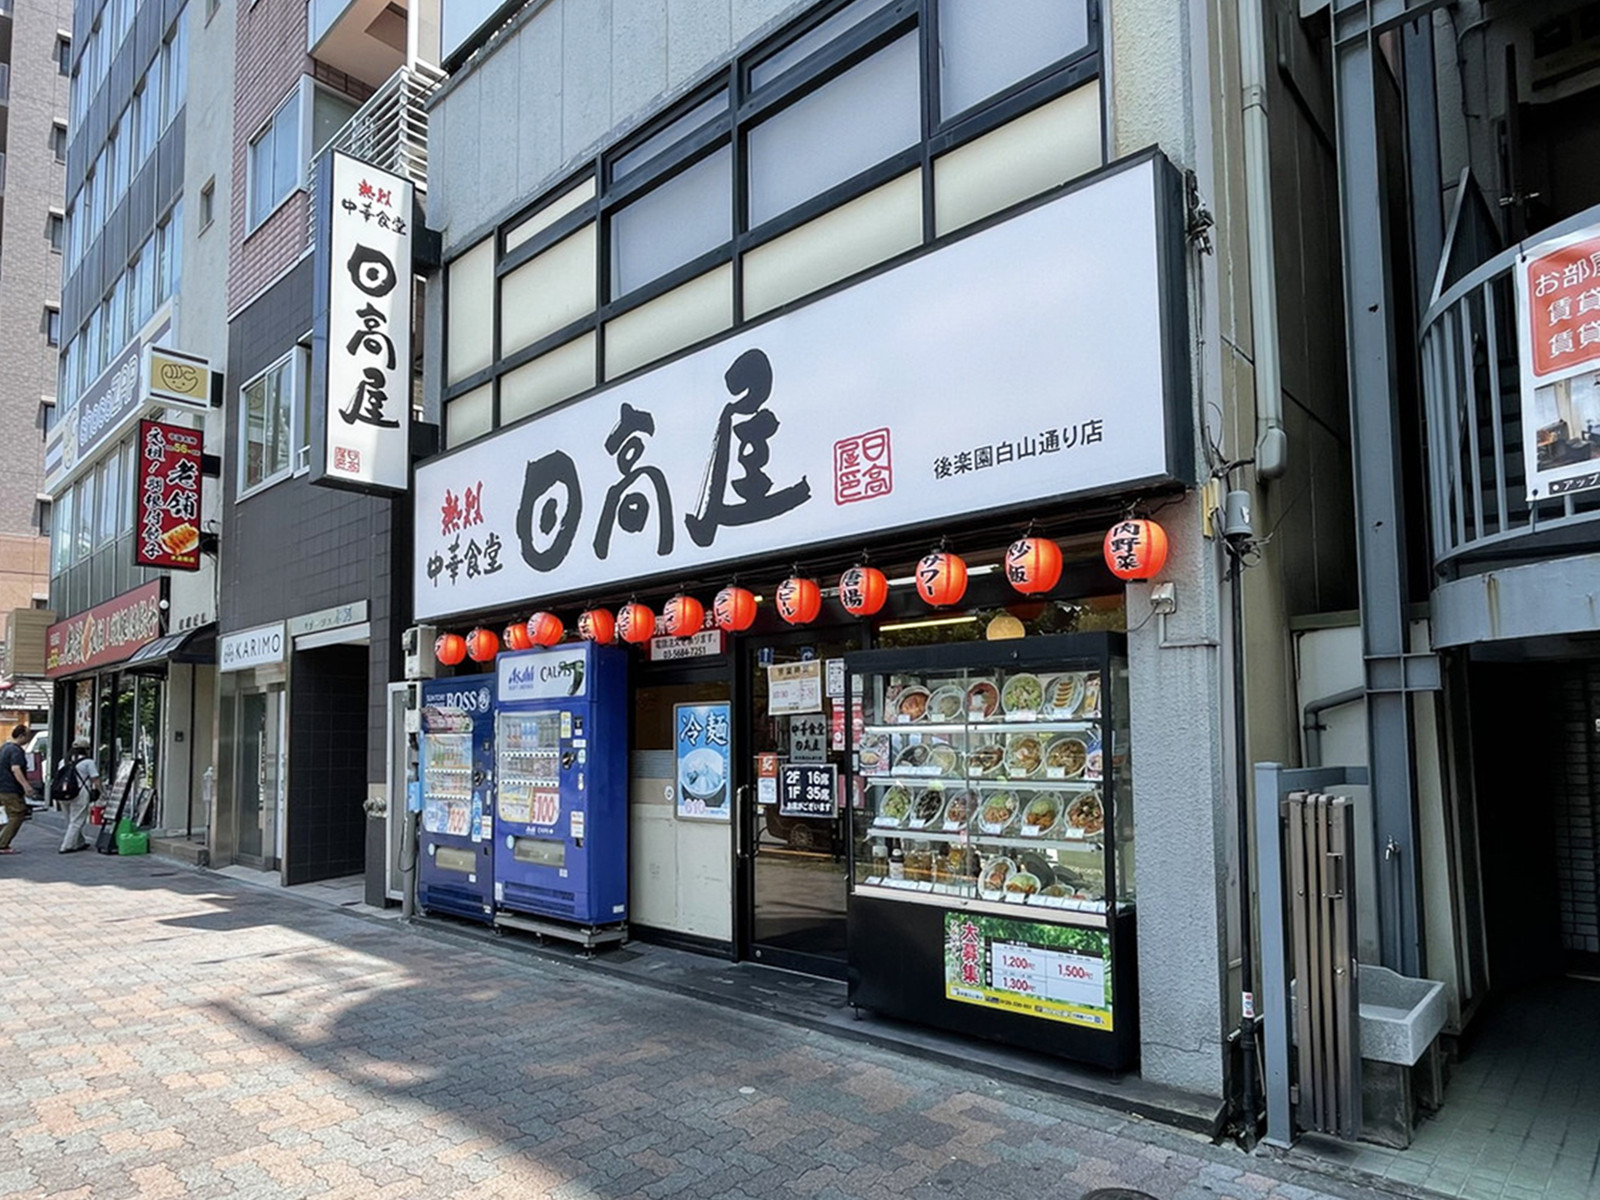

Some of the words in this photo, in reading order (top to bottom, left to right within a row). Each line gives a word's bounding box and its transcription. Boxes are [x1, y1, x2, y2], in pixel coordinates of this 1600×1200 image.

[358, 179, 392, 208] 熱烈
[341, 198, 407, 236] 中華食堂
[1547, 287, 1600, 327] 賃貸
[336, 243, 401, 428] 日高屋
[1549, 320, 1600, 358] 賃貸
[516, 348, 811, 573] 日高屋
[933, 420, 1103, 480] 後楽園白山通り店
[441, 480, 484, 536] 熱烈
[427, 531, 503, 588] 中華食堂
[1007, 540, 1033, 585] 炒飯
[1110, 522, 1141, 571] 肉野菜
[919, 553, 946, 597] サワー
[777, 579, 797, 616] 生ビール
[235, 633, 281, 661] KARIMO
[446, 690, 477, 711] BOSS
[680, 711, 729, 747] 冷麺
[786, 771, 800, 784] 2F
[787, 786, 801, 799] 1F
[961, 921, 981, 986] 大募集
